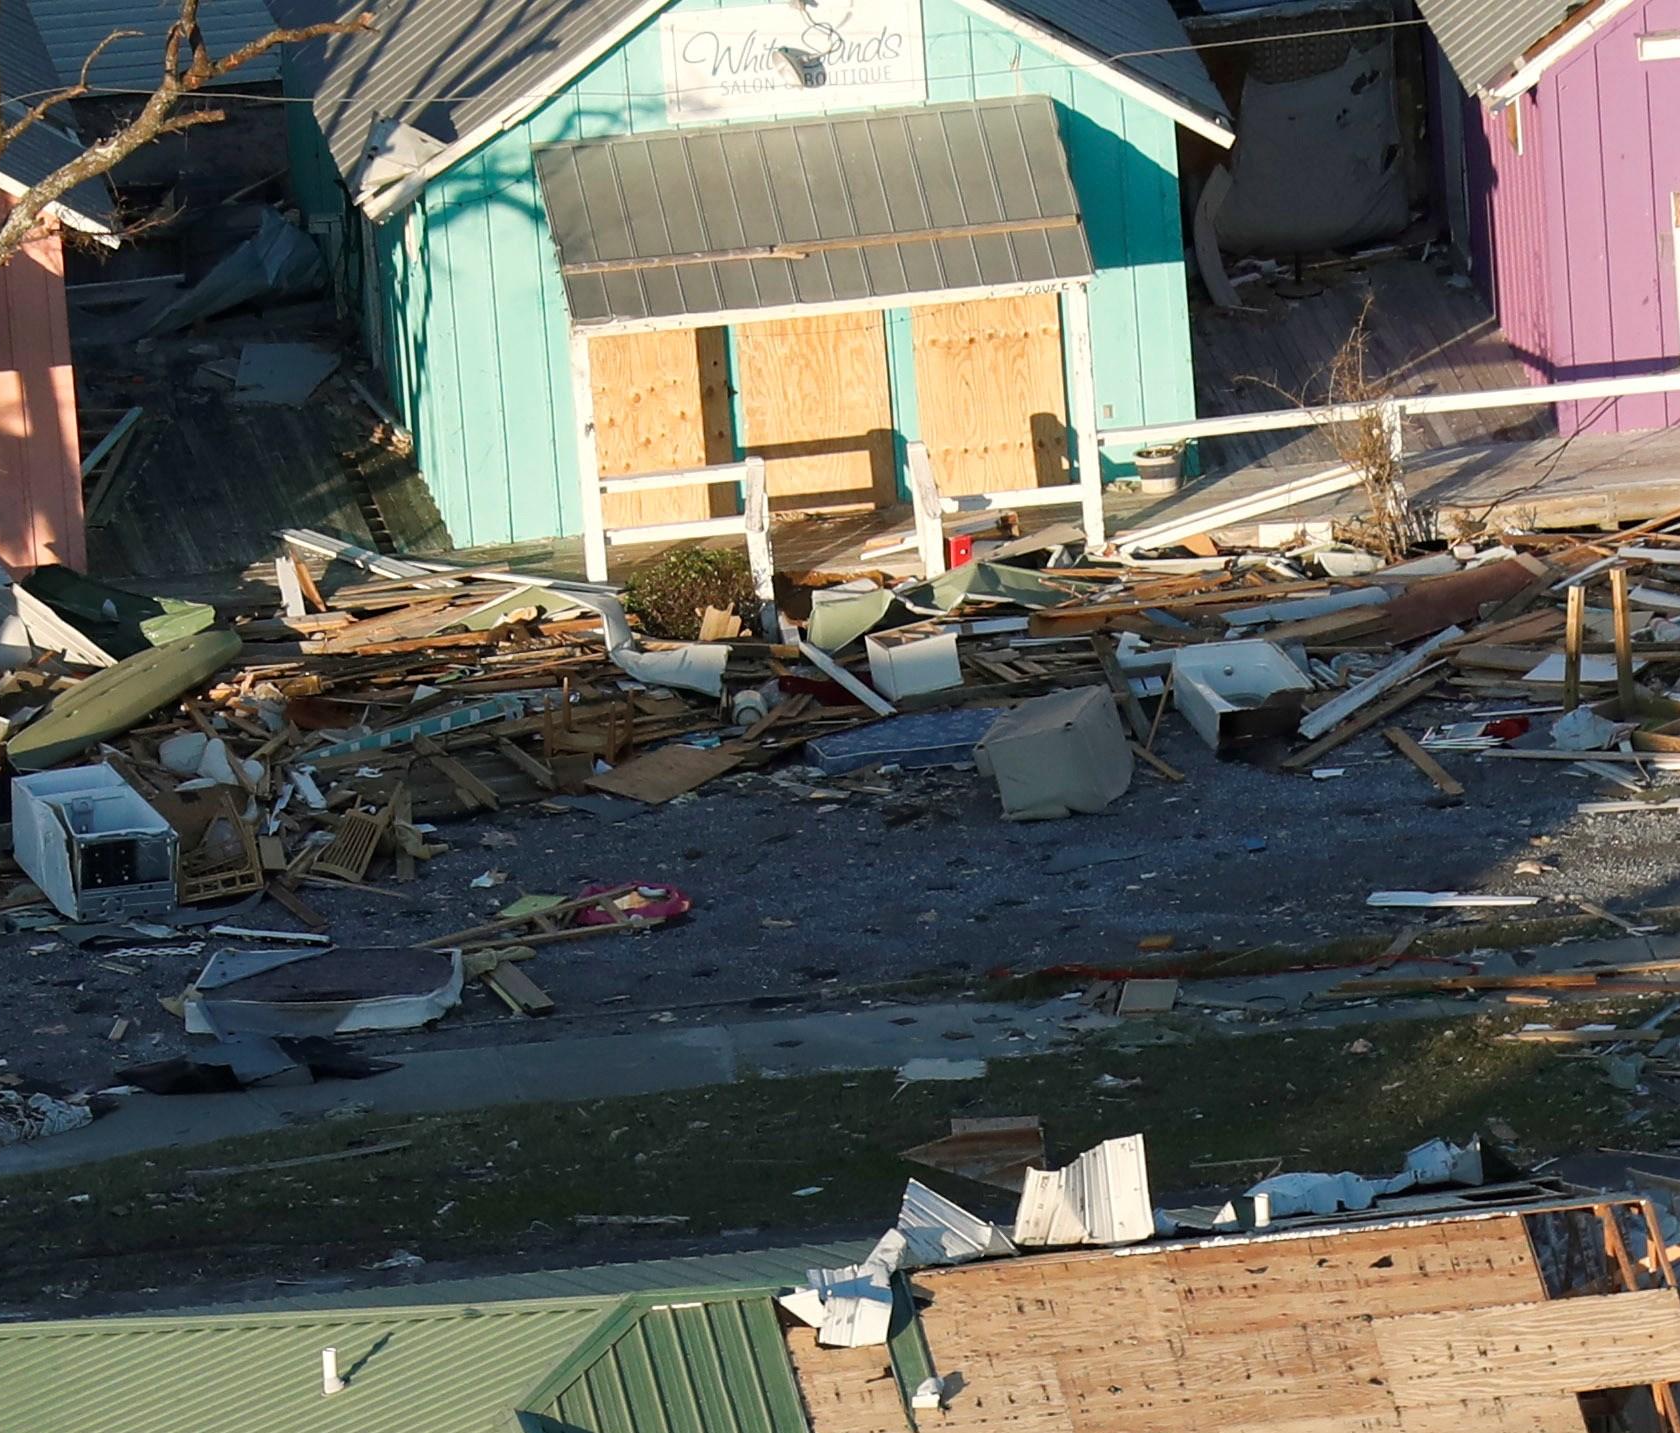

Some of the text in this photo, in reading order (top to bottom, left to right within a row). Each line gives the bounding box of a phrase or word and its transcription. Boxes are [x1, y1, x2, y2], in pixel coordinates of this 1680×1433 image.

[683, 23, 902, 76] Whit Sands
[721, 77, 776, 97] SALON
[803, 65, 893, 87] BOUTIQUE
